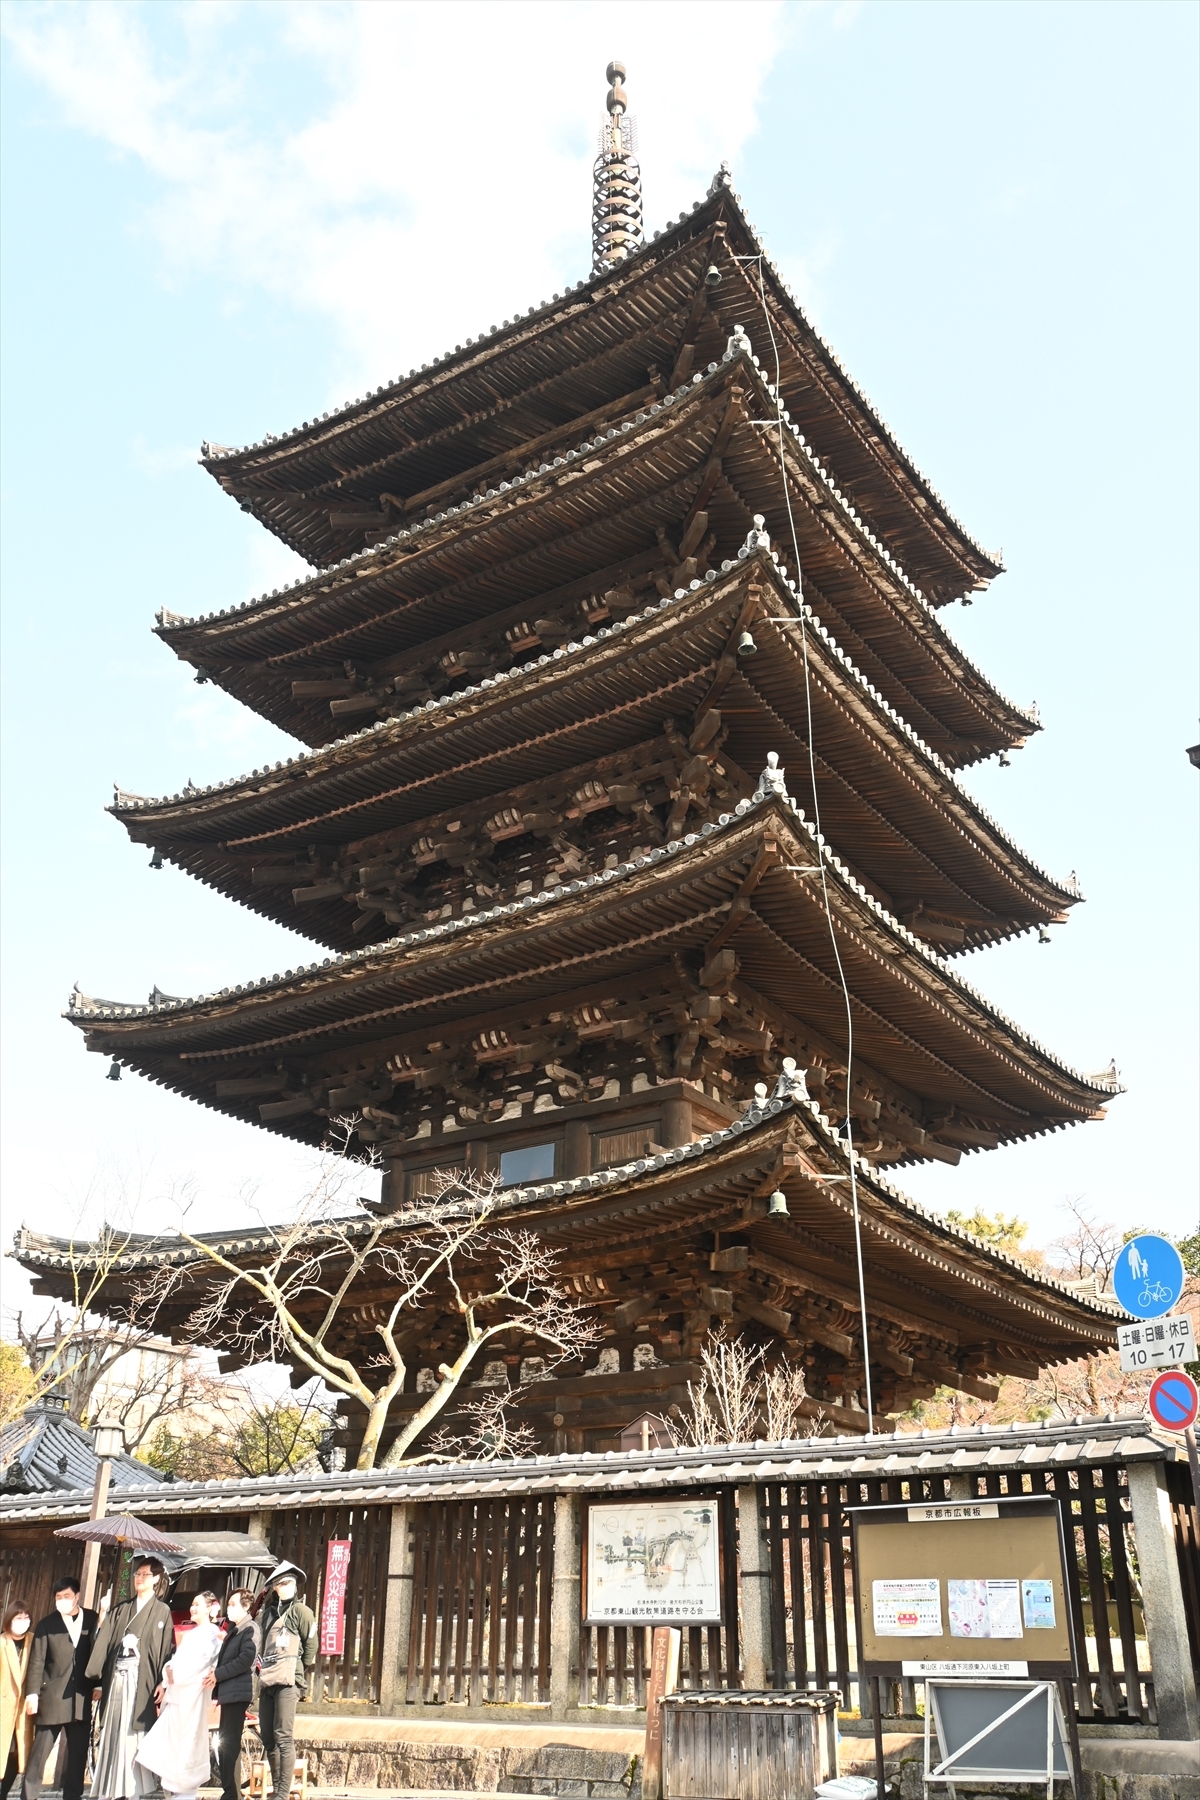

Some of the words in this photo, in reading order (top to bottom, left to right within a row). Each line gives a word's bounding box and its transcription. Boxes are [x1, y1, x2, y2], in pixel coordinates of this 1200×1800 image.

[1122, 1320, 1189, 1347] 土曜・日曜・休日
[925, 1507, 981, 1519] 京都市広報板
[325, 1544, 344, 1651] 無火災推進日
[920, 1663, 937, 1671] 東山区
